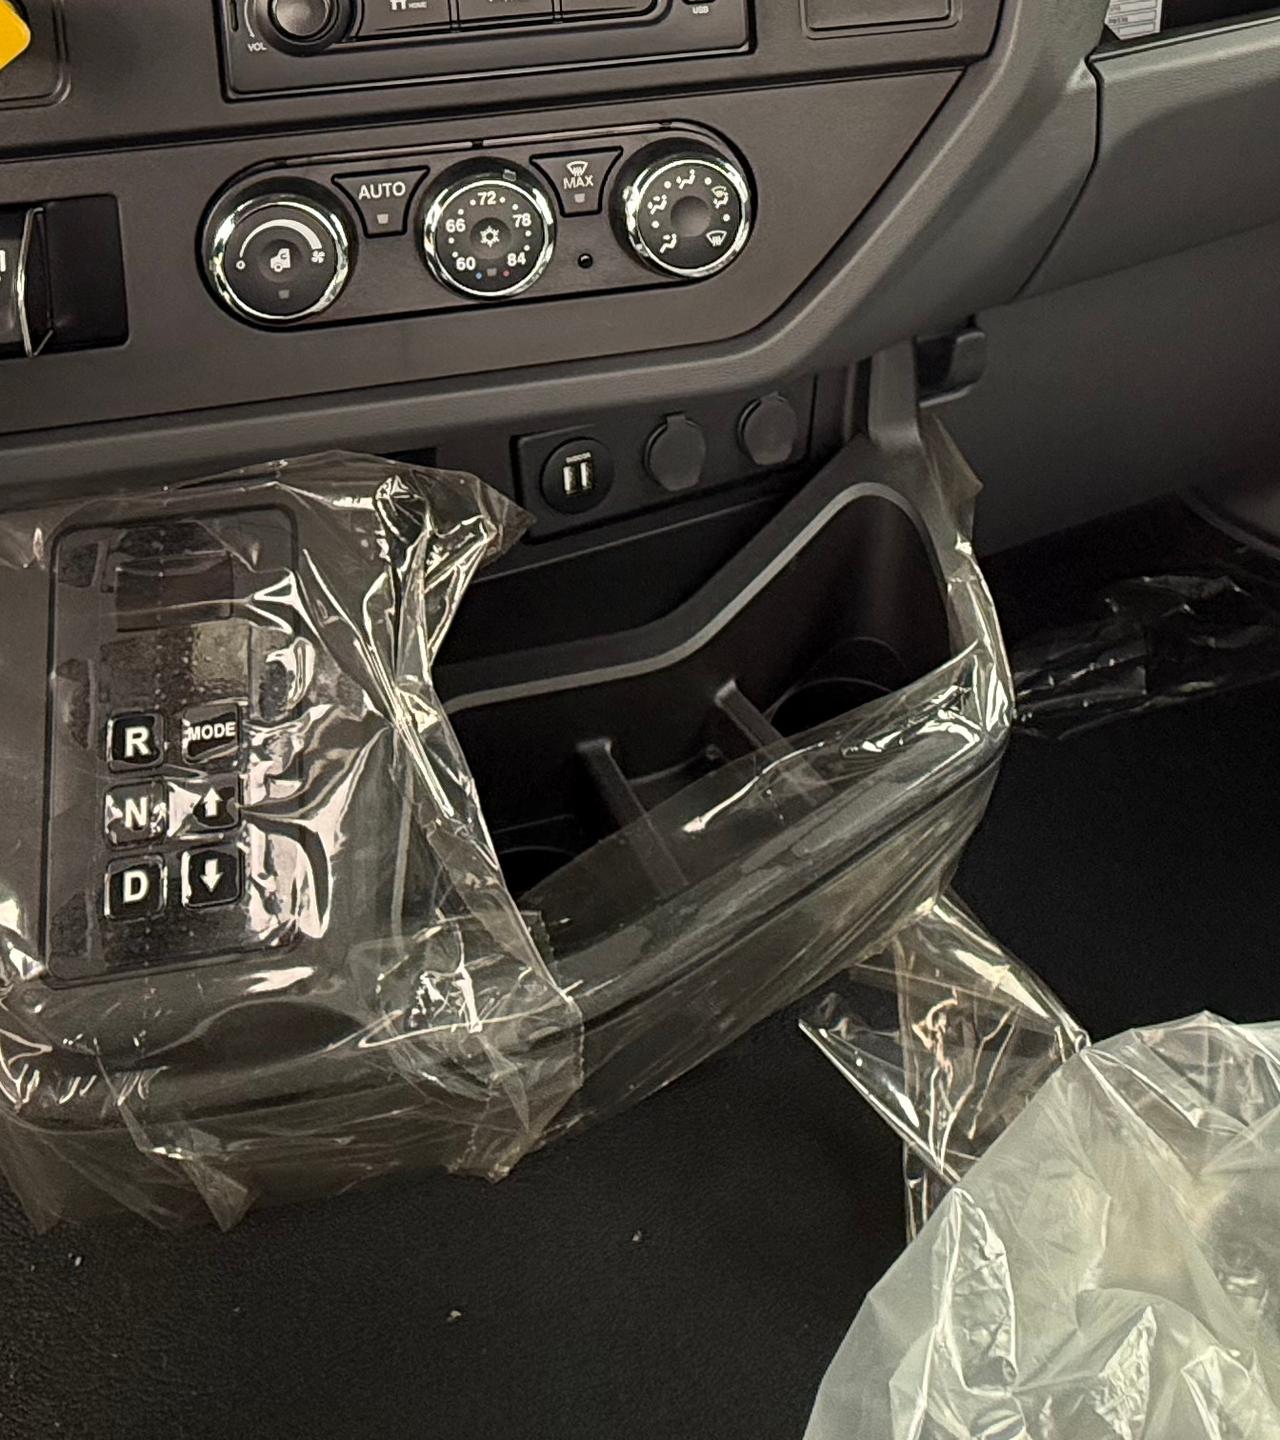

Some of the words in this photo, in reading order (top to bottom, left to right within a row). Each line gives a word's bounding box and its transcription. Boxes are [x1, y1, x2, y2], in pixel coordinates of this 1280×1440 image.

[248, 42, 267, 52] VOL
[563, 173, 595, 189] MAX
[358, 182, 406, 200] AUTO
[477, 191, 497, 206] 72
[445, 219, 466, 233] 66
[512, 213, 531, 228] 78
[455, 257, 476, 270] 60
[507, 252, 526, 266] 84
[188, 720, 236, 740] MODE
[125, 726, 150, 757] R
[124, 796, 149, 829] N
[123, 871, 147, 903] D
